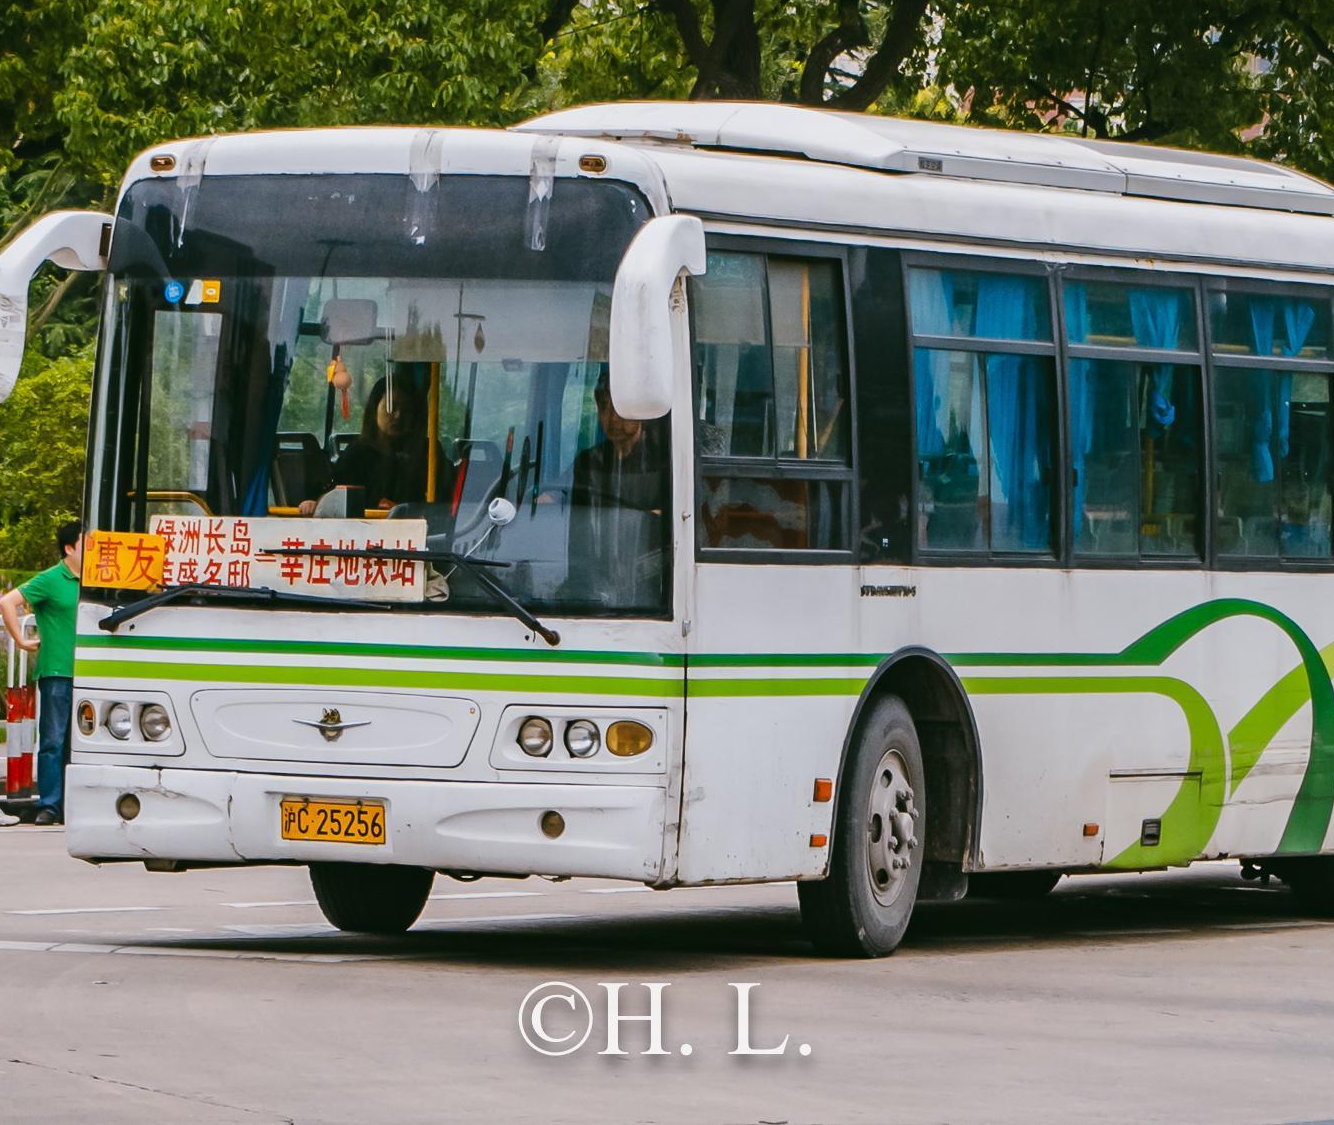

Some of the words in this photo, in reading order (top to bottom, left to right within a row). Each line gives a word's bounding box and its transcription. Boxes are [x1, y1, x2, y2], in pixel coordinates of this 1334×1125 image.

[95, 536, 160, 585] 惠友
[156, 518, 252, 557] 绿洲长岛
[280, 537, 418, 587] 莘庄地铁站
